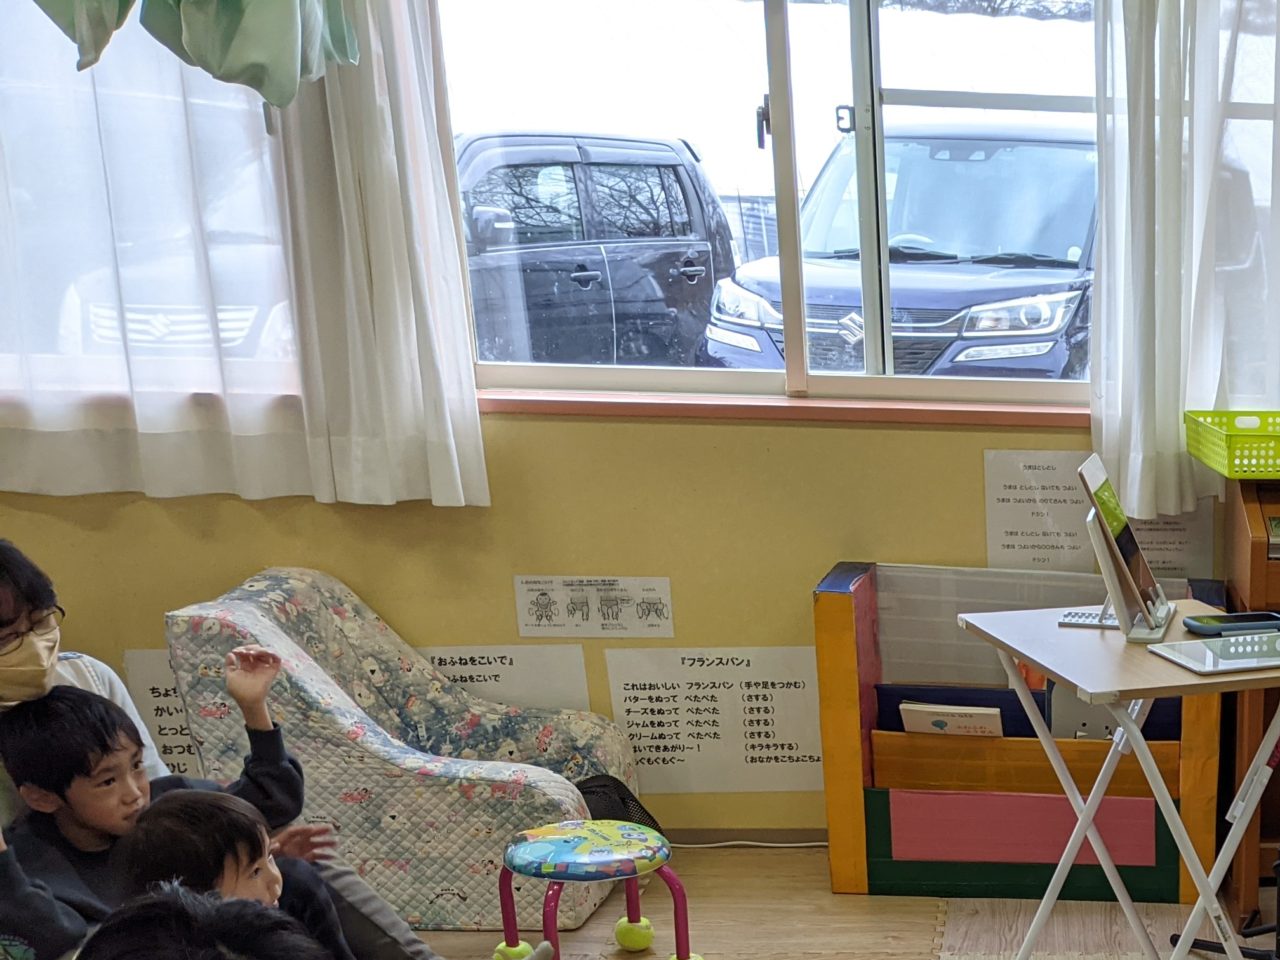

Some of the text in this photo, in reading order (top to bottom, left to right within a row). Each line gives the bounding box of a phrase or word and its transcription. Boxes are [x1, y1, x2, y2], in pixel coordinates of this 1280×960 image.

[430, 655, 514, 667] 『おふねをこいで』
[681, 656, 751, 668] 『フランスパン』
[623, 682, 680, 691] これはおいしい
[686, 681, 734, 690] フランスパン
[624, 694, 678, 703] バターをぬって
[684, 694, 718, 703] べたべた
[154, 706, 183, 717] かい
[625, 707, 680, 716] チーズをぬって
[686, 706, 720, 715] べたべた
[627, 720, 680, 729] ジャムをぬって
[686, 719, 720, 728] べたべた
[158, 725, 190, 736] とっと
[628, 732, 681, 741] クリームぬって
[687, 732, 721, 740] べたべた
[162, 744, 195, 755] おつむ
[635, 757, 685, 766] ぐもぐもぐ〜
